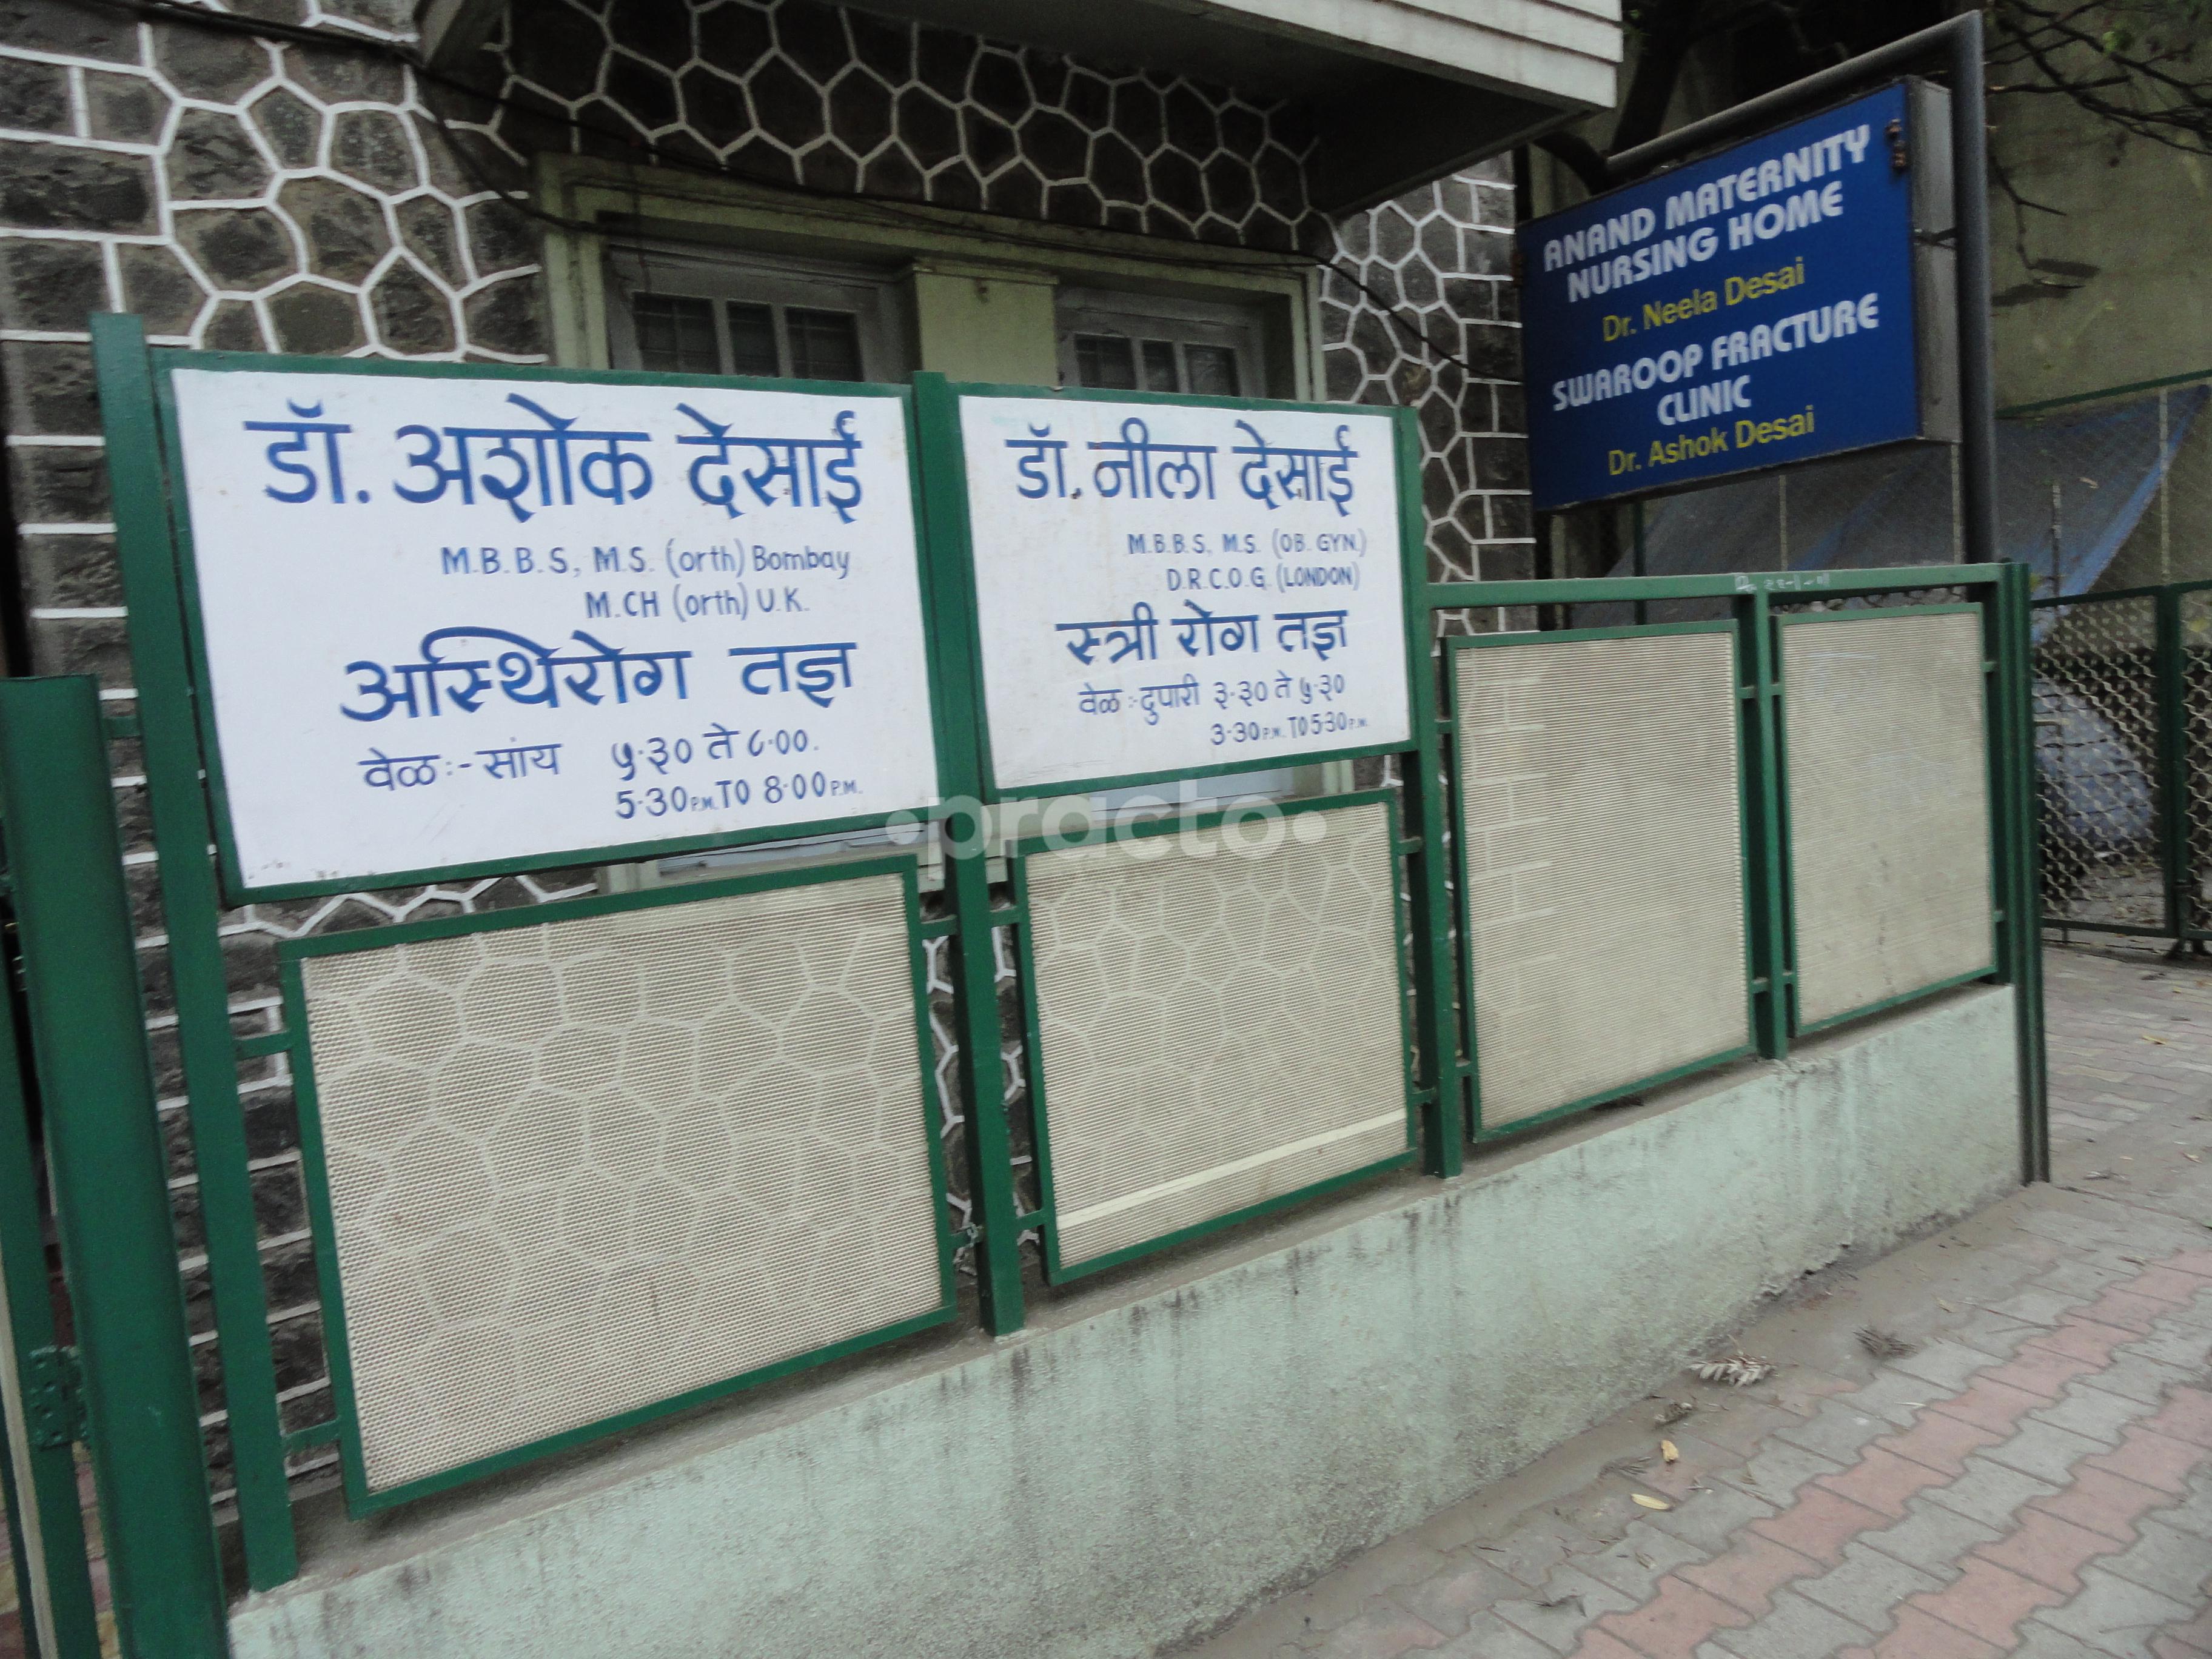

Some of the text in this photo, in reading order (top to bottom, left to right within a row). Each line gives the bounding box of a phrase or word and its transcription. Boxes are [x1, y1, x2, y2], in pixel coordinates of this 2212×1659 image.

[1544, 124, 1871, 272] ANAND MATERNITY
[1568, 181, 1843, 302] NURSING HOME
[1603, 256, 1806, 341] Dr. Neela Desai
[1552, 292, 1880, 411] SWAROOP FRACTURE
[1657, 375, 1752, 426] CLINIC
[243, 392, 863, 525] डॉ. अशोक देसाई
[1087, 417, 1219, 500] नीला
[1231, 418, 1360, 517] देसाई
[1608, 405, 1815, 475] Dr. Ashok Desai
[666, 538, 745, 578] (orth)
[752, 545, 850, 580] Bombay
[1276, 561, 1360, 594] (LONDON)
[585, 591, 660, 618] M.CH
[672, 581, 749, 623] (orth)
[1054, 601, 1161, 666] स्त्री
[1170, 598, 1261, 658] रोग
[340, 626, 693, 722] अस्थिरोग
[1138, 672, 1201, 726] दुपारी
[1275, 669, 1293, 699] ते
[702, 722, 741, 760] ते
